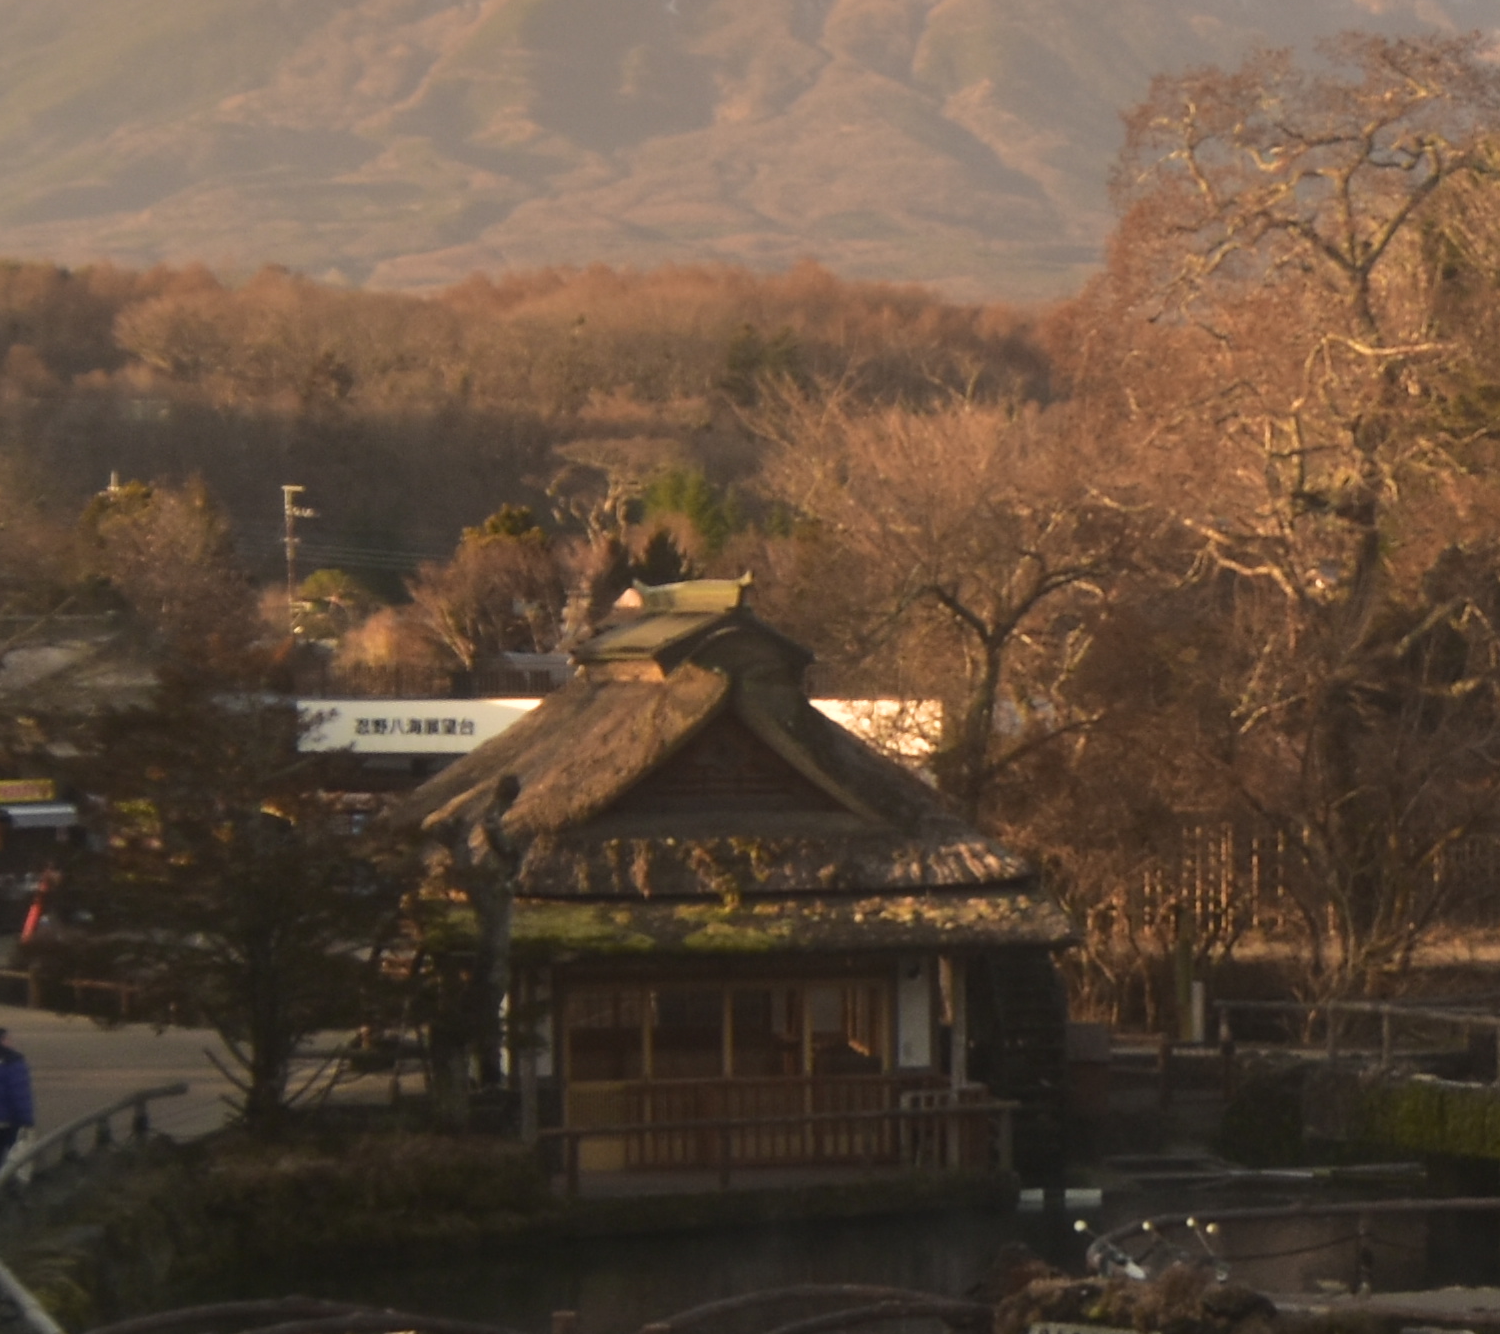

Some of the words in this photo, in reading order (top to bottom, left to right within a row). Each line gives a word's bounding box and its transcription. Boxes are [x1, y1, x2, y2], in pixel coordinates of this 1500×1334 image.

[355, 717, 476, 736] 忍野八海展望台
